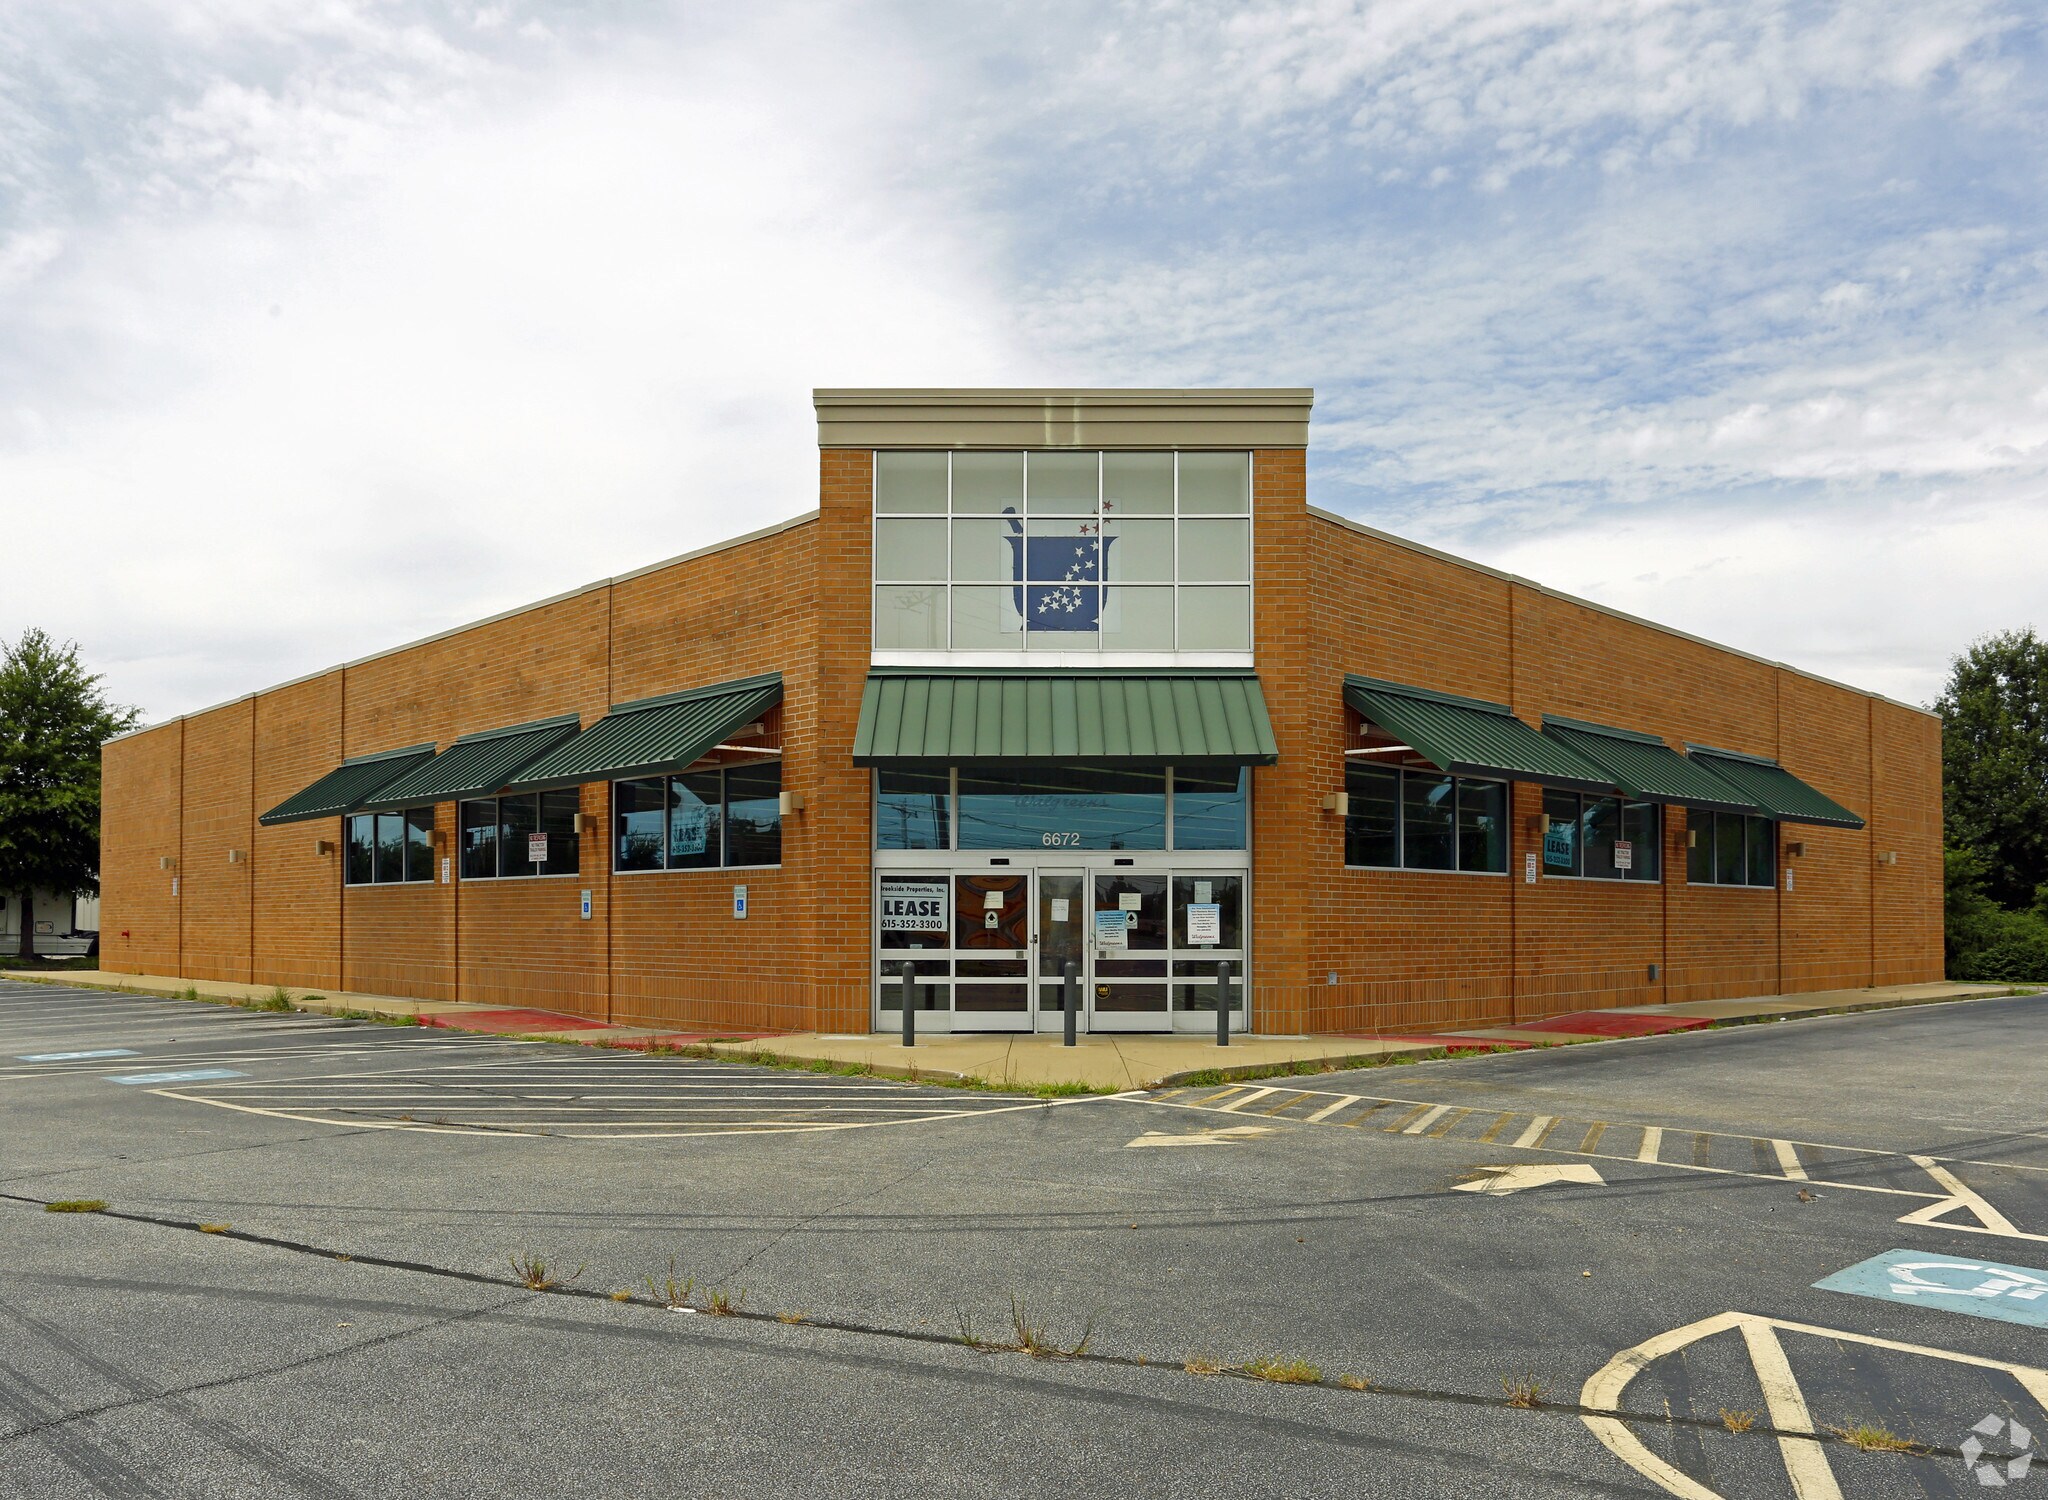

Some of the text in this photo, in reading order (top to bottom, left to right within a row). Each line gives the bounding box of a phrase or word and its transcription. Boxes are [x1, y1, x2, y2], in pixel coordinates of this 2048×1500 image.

[1042, 832, 1080, 846] 6672
[1547, 839, 1570, 855] LEASE
[883, 900, 940, 917] LEASE
[881, 919, 943, 929] 615-352-3300
